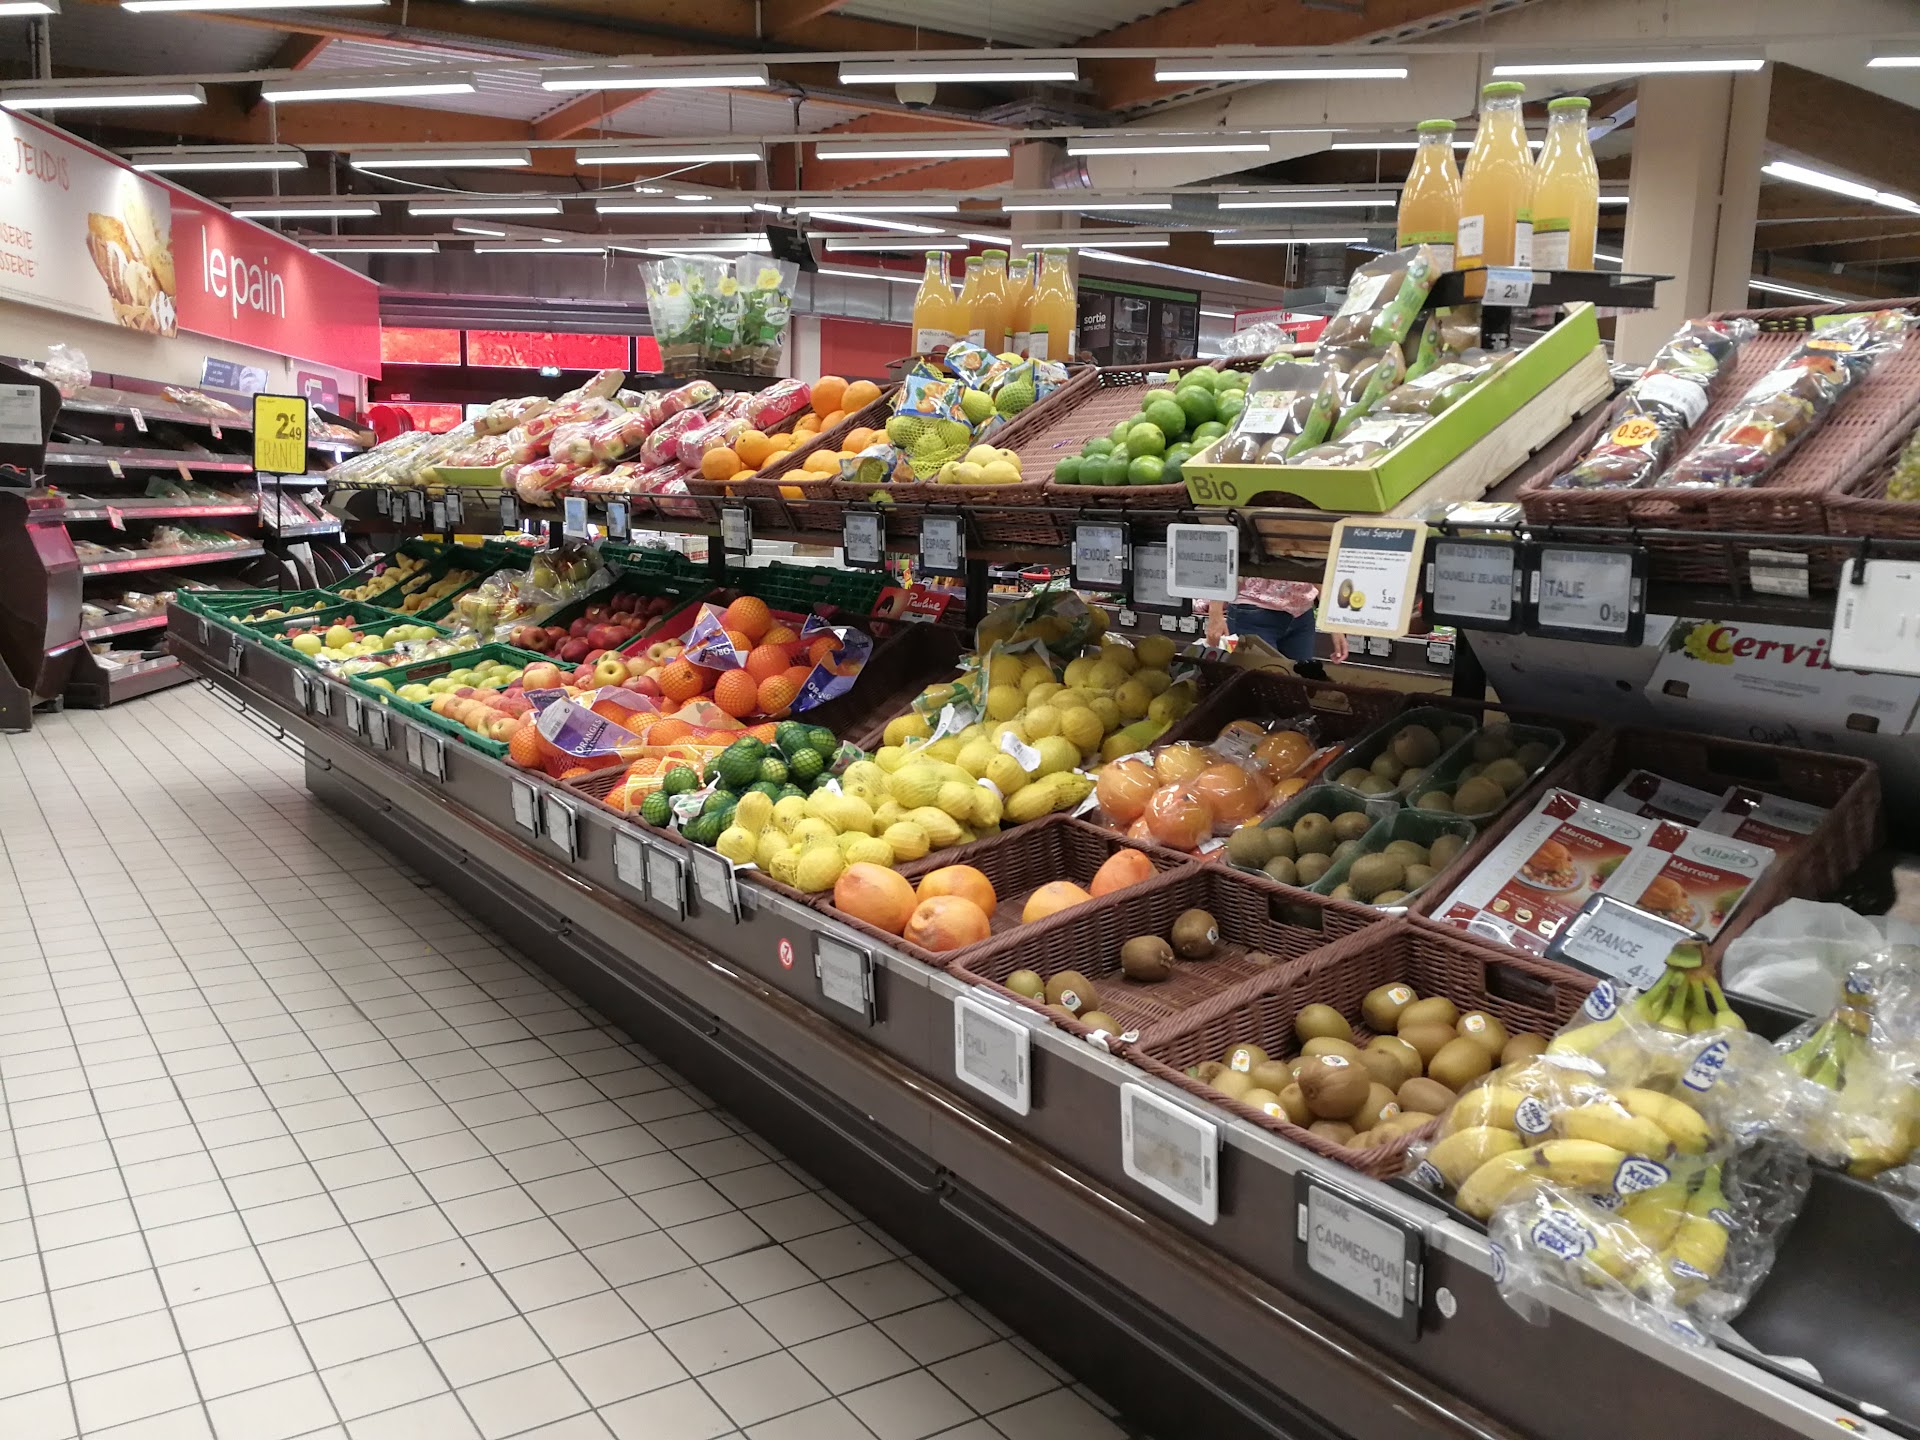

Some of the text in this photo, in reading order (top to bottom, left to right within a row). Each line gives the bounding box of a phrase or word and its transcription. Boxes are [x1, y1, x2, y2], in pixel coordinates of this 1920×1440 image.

[14, 137, 70, 191] JEUDIS
[0, 222, 33, 249] SERIE
[1083, 312, 1106, 325] sortie
[1191, 472, 1238, 501] Bio
[926, 537, 951, 551] ESPAGNE
[1353, 528, 1370, 537] Kiwi
[1079, 547, 1111, 562] MEXIQUE
[1544, 578, 1585, 600] ITALIE
[909, 591, 942, 612] Pauline
[575, 718, 602, 753] ORANGES
[1559, 826, 1605, 849] Marrons
[1701, 846, 1750, 866] Allaire
[1669, 859, 1721, 882] Marrons
[1582, 924, 1644, 959] FRANCE
[1315, 1223, 1400, 1284] CARMEROUN
